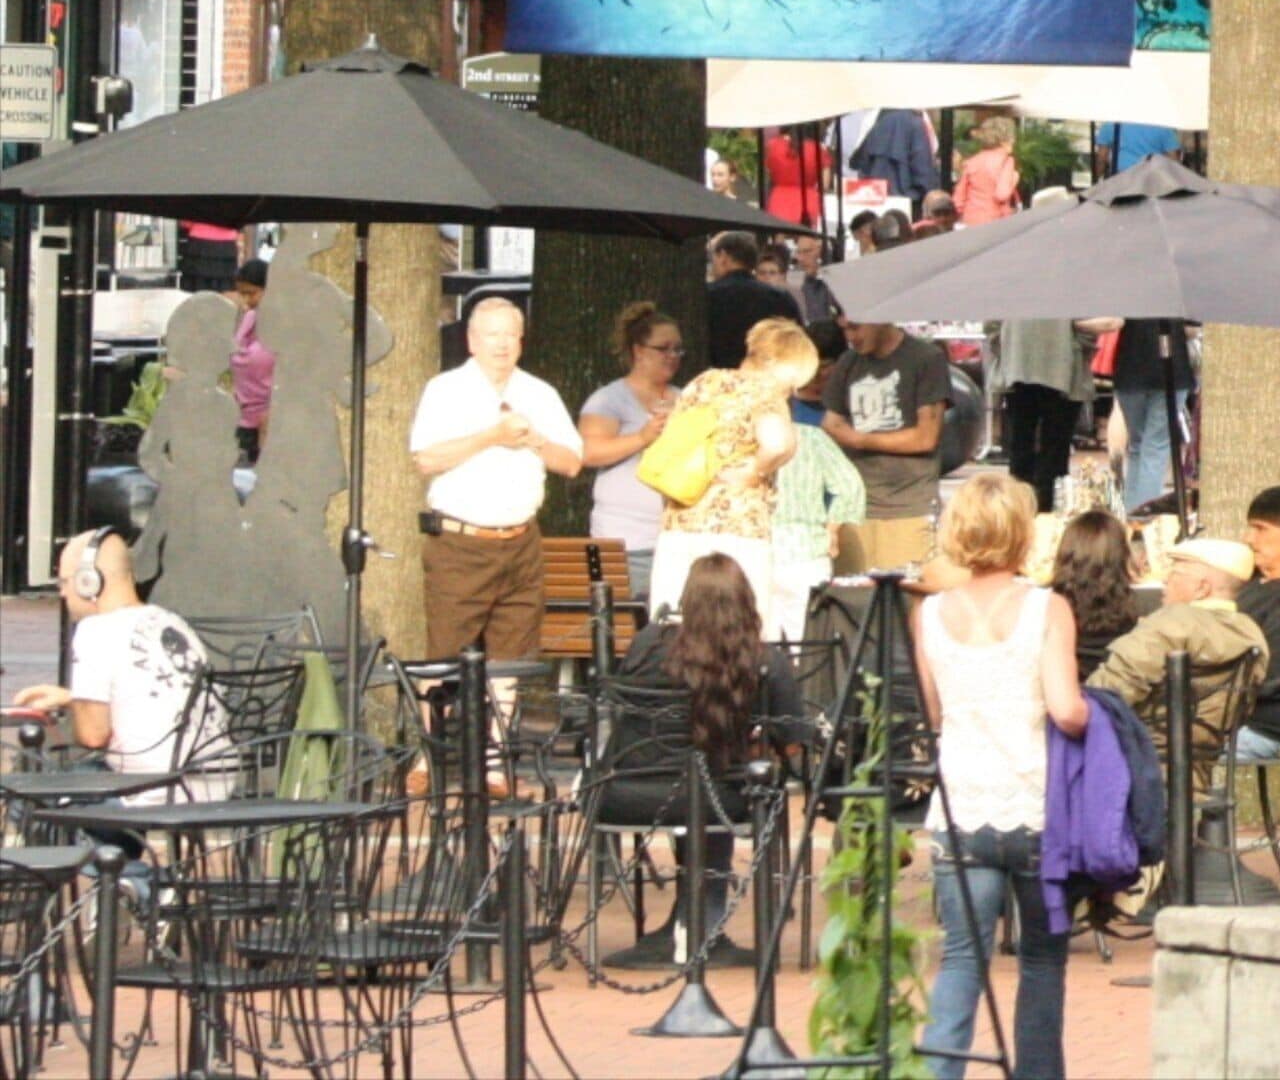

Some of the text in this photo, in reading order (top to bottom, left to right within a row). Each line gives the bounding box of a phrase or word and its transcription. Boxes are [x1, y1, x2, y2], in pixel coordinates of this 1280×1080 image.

[0, 63, 52, 78] CAUTION
[467, 67, 493, 83] 2nd
[0, 86, 49, 101] VEHICLE
